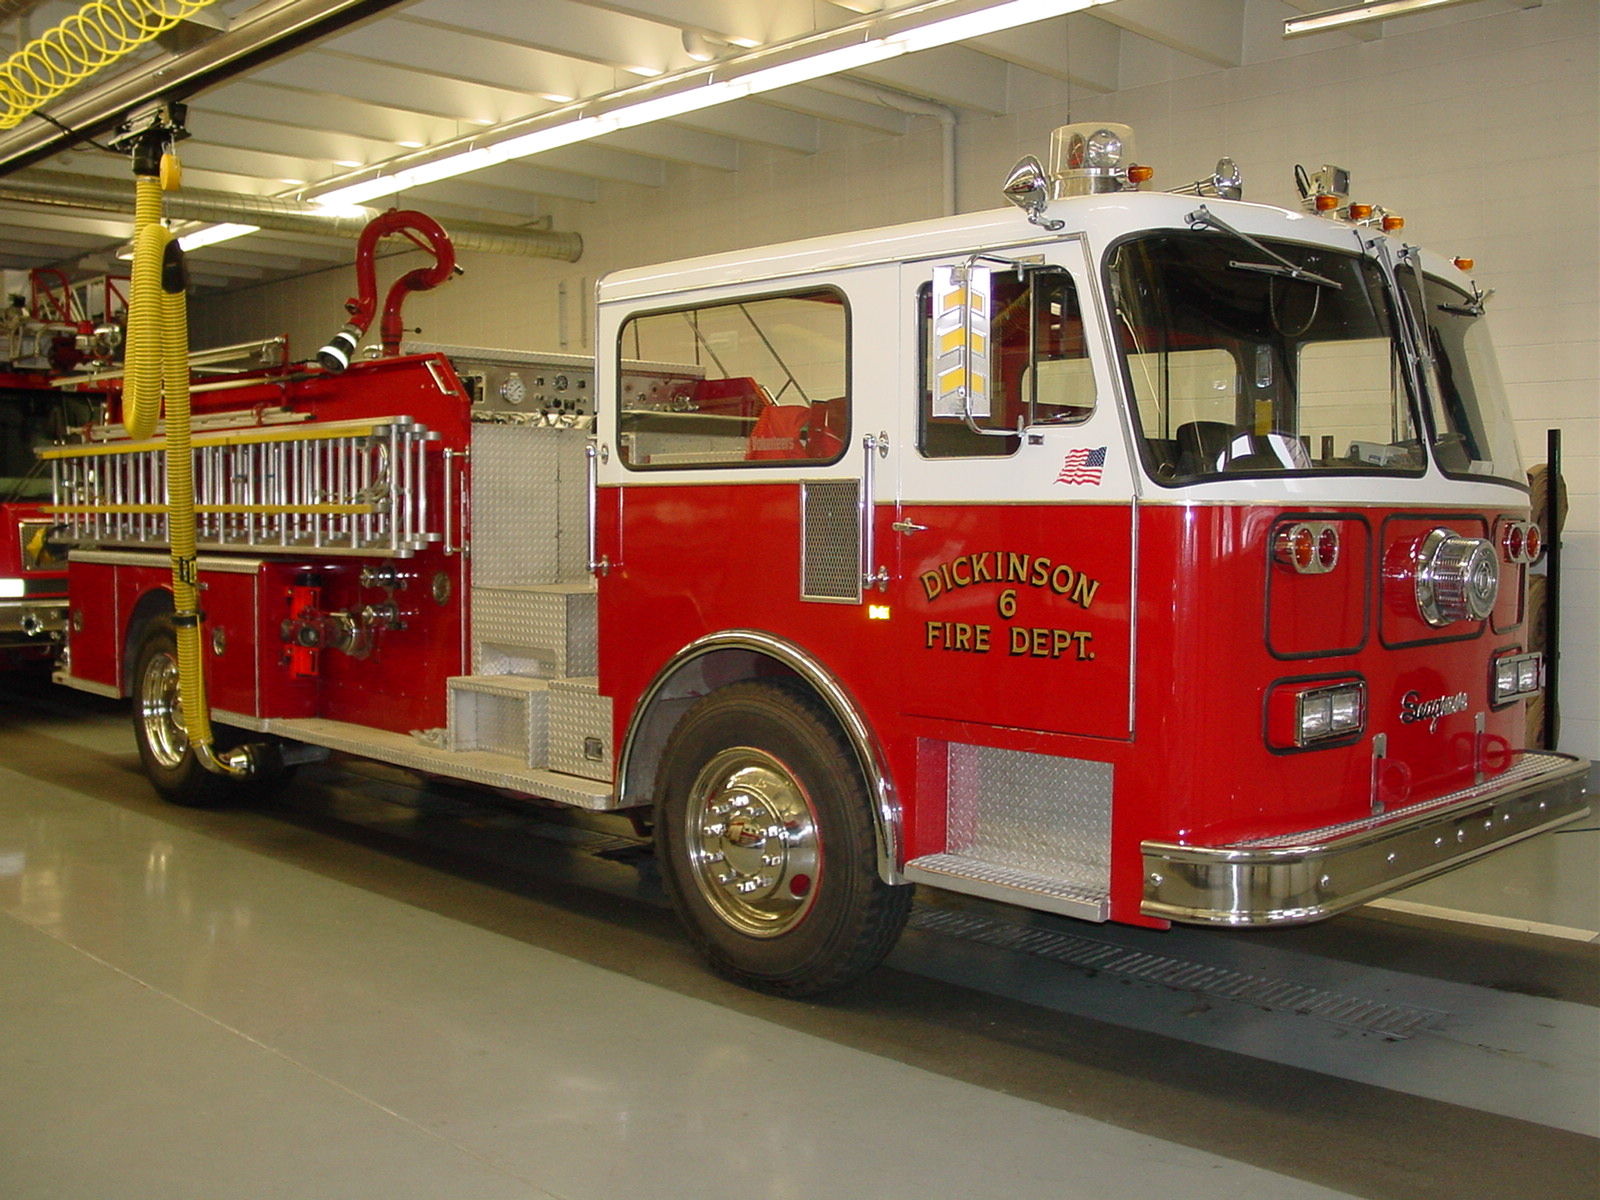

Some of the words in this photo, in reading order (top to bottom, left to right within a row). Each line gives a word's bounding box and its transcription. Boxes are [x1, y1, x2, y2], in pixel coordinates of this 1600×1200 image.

[920, 551, 1100, 609] DICKINSON
[998, 589, 1017, 619] 6
[926, 621, 991, 654] FIRE
[1009, 626, 1096, 661] DEPT.
